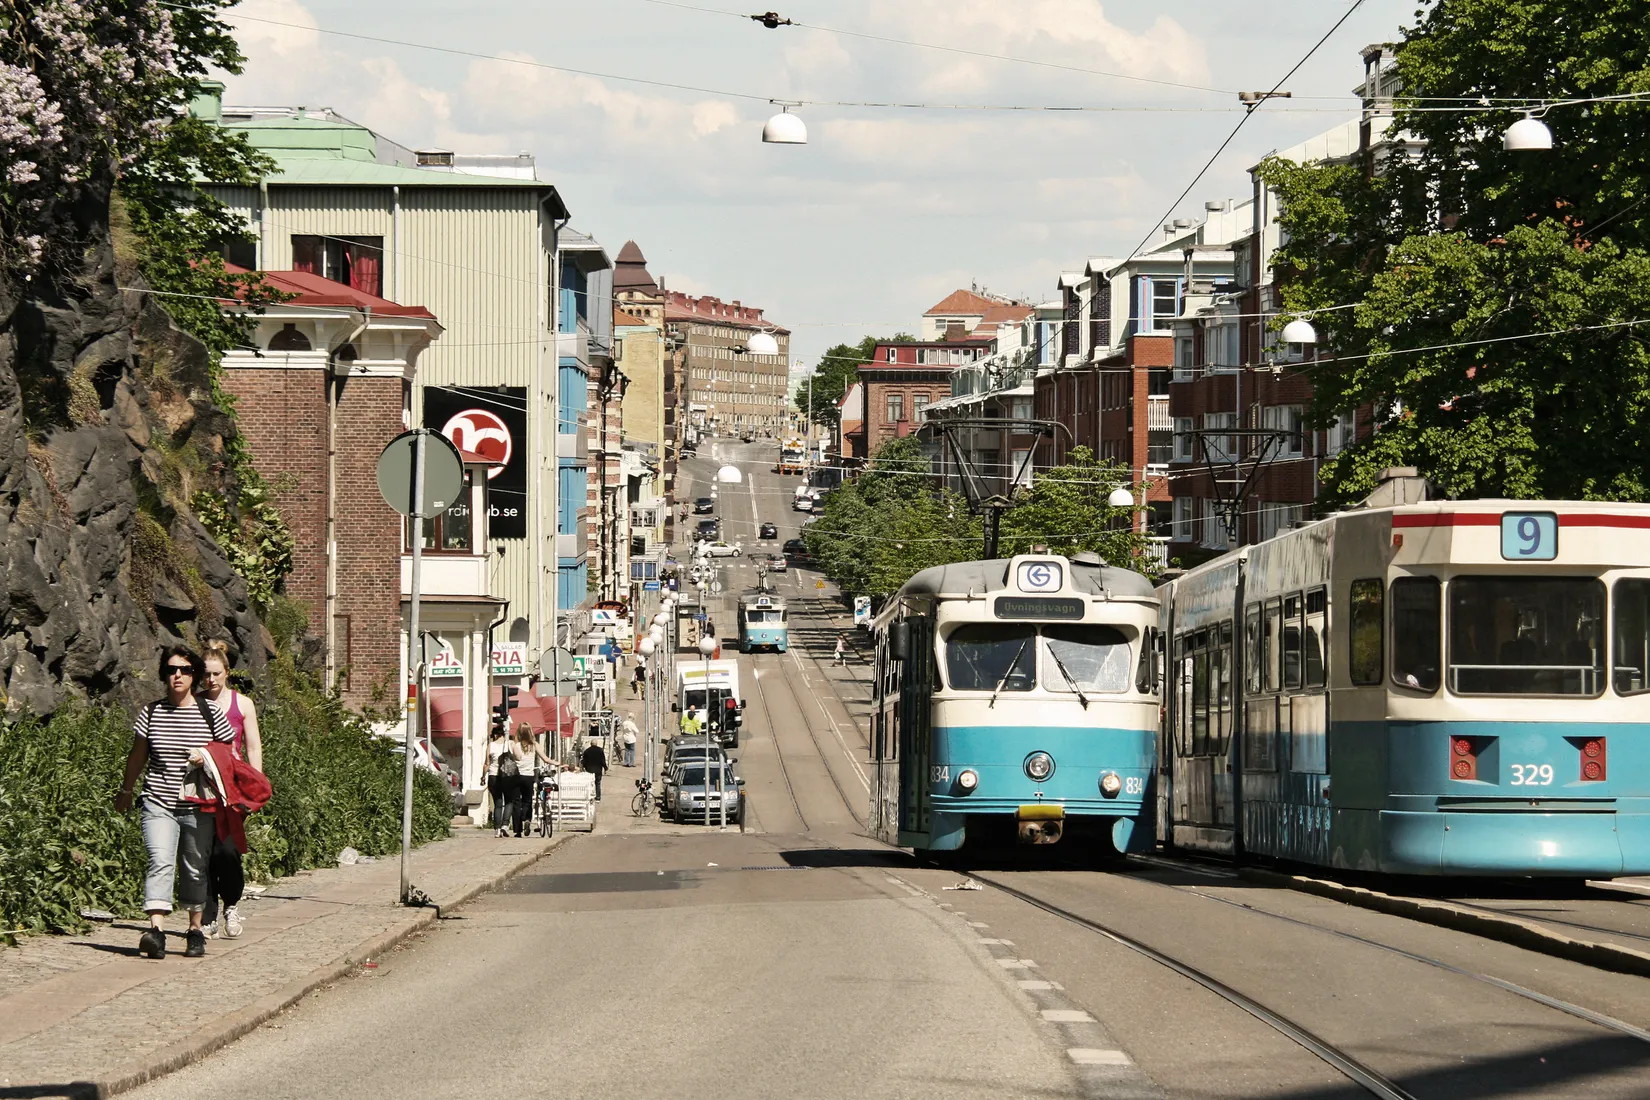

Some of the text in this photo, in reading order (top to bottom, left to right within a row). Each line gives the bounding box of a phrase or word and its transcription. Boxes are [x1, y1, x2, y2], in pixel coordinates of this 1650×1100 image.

[1517, 516, 1541, 555] 9
[930, 765, 950, 783] 834
[1510, 763, 1554, 786] 329
[1126, 776, 1143, 795] 834
